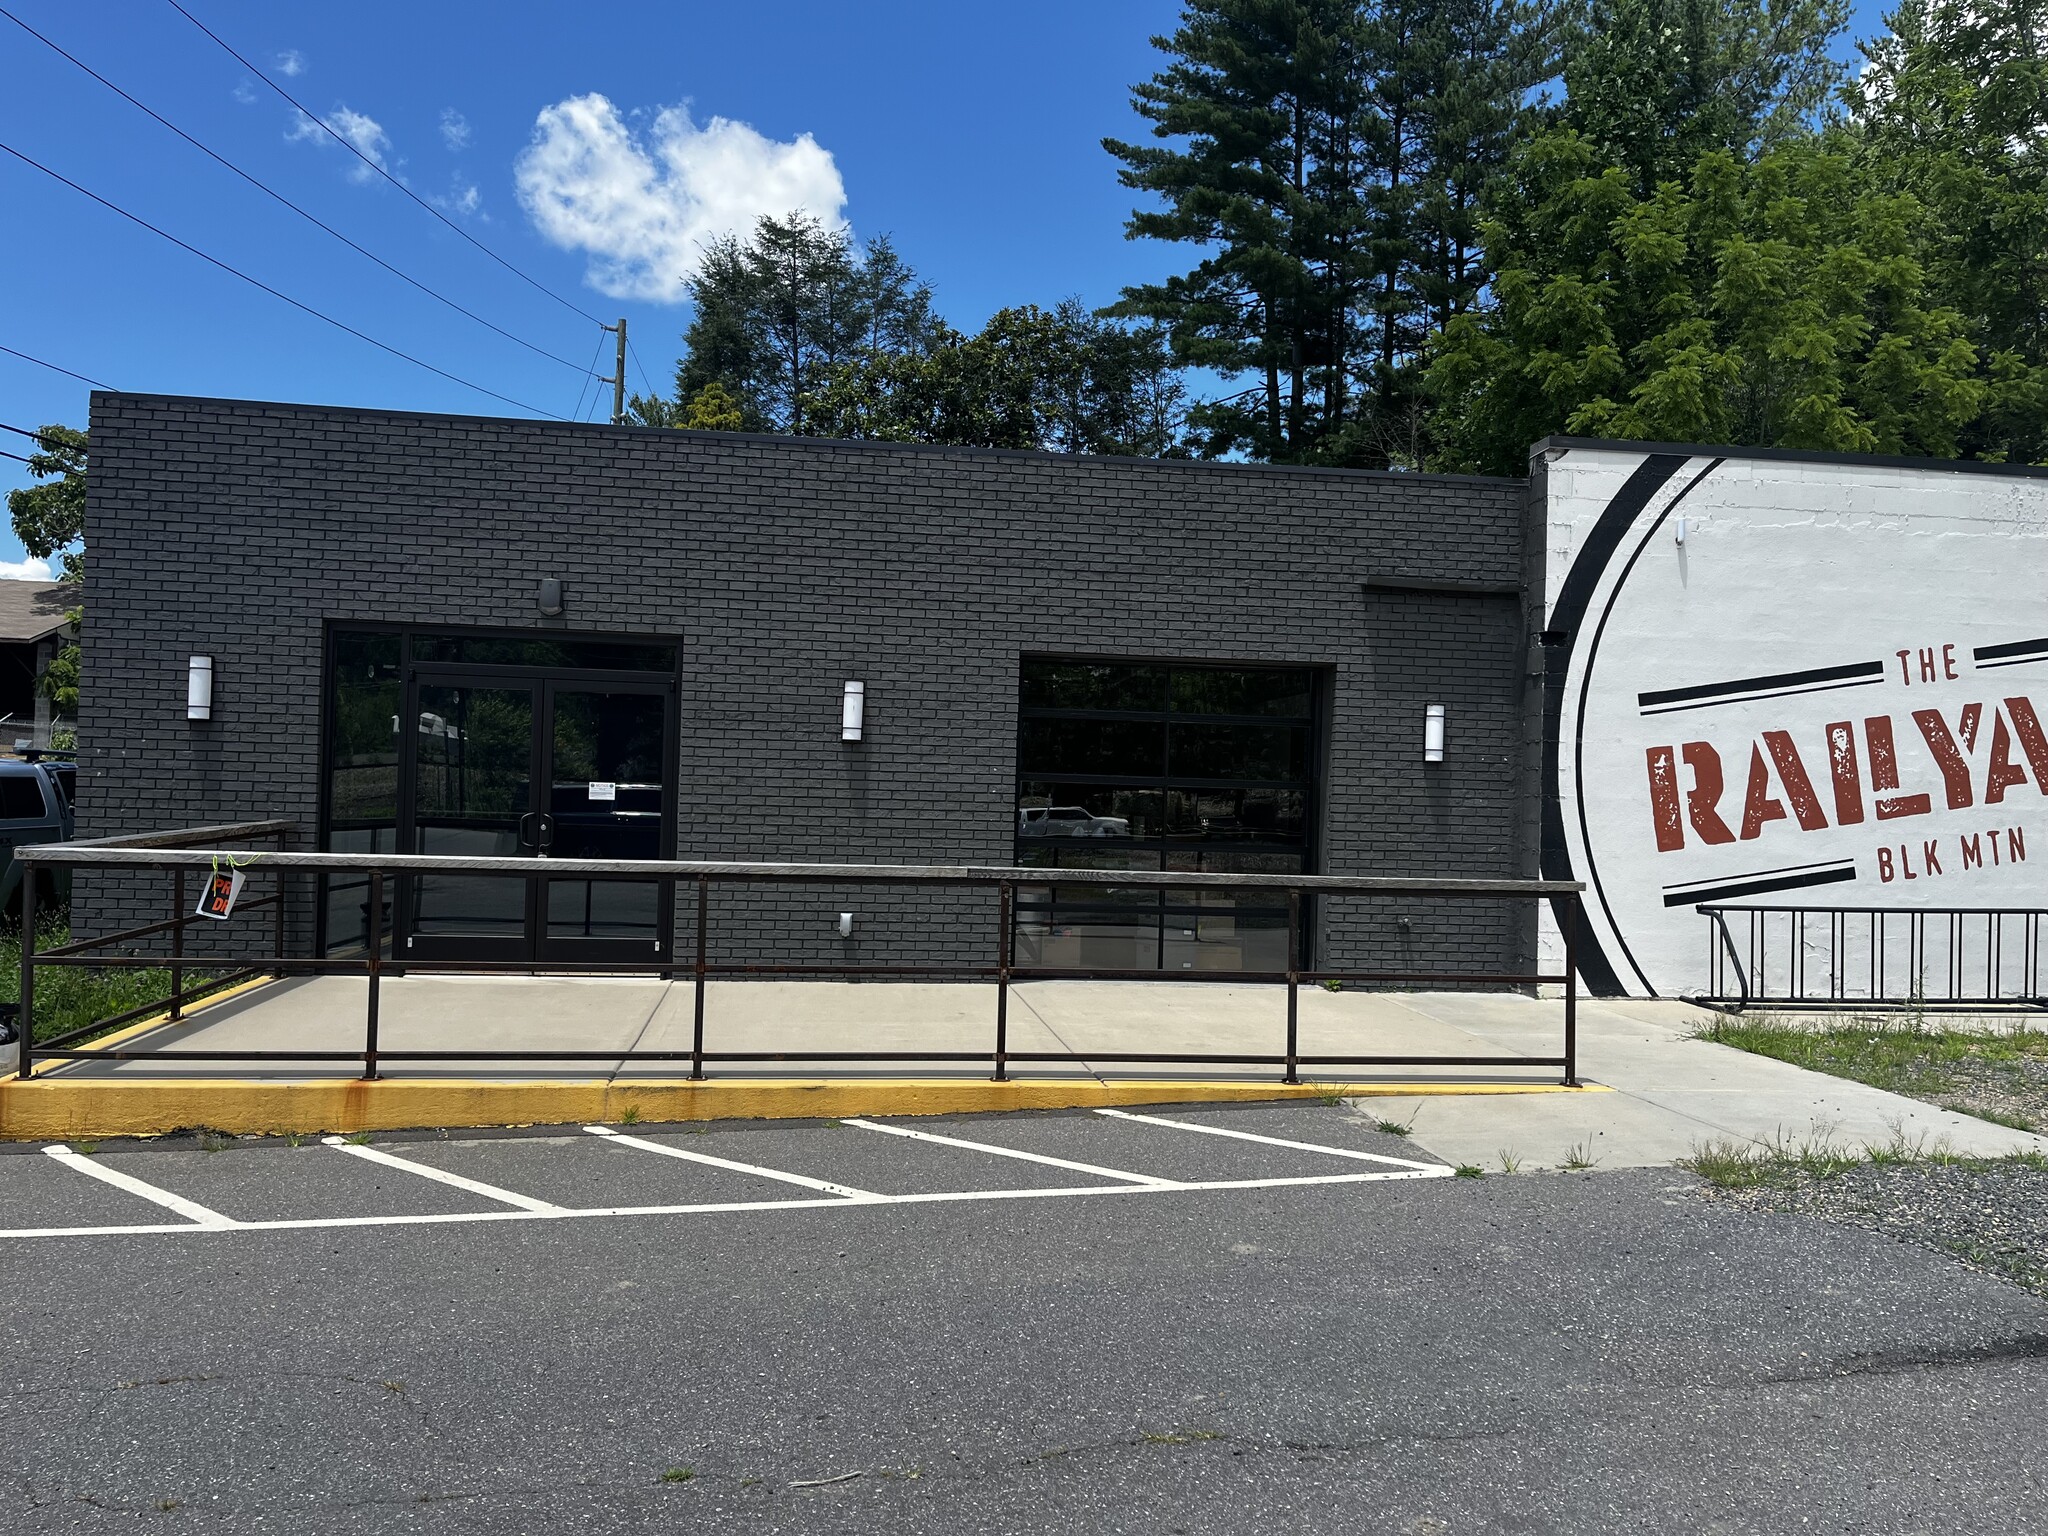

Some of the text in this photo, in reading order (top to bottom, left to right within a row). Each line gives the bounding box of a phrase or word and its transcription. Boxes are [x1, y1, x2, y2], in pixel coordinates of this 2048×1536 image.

[1896, 644, 1959, 685] THE
[1877, 826, 2026, 883] BLK MTN
